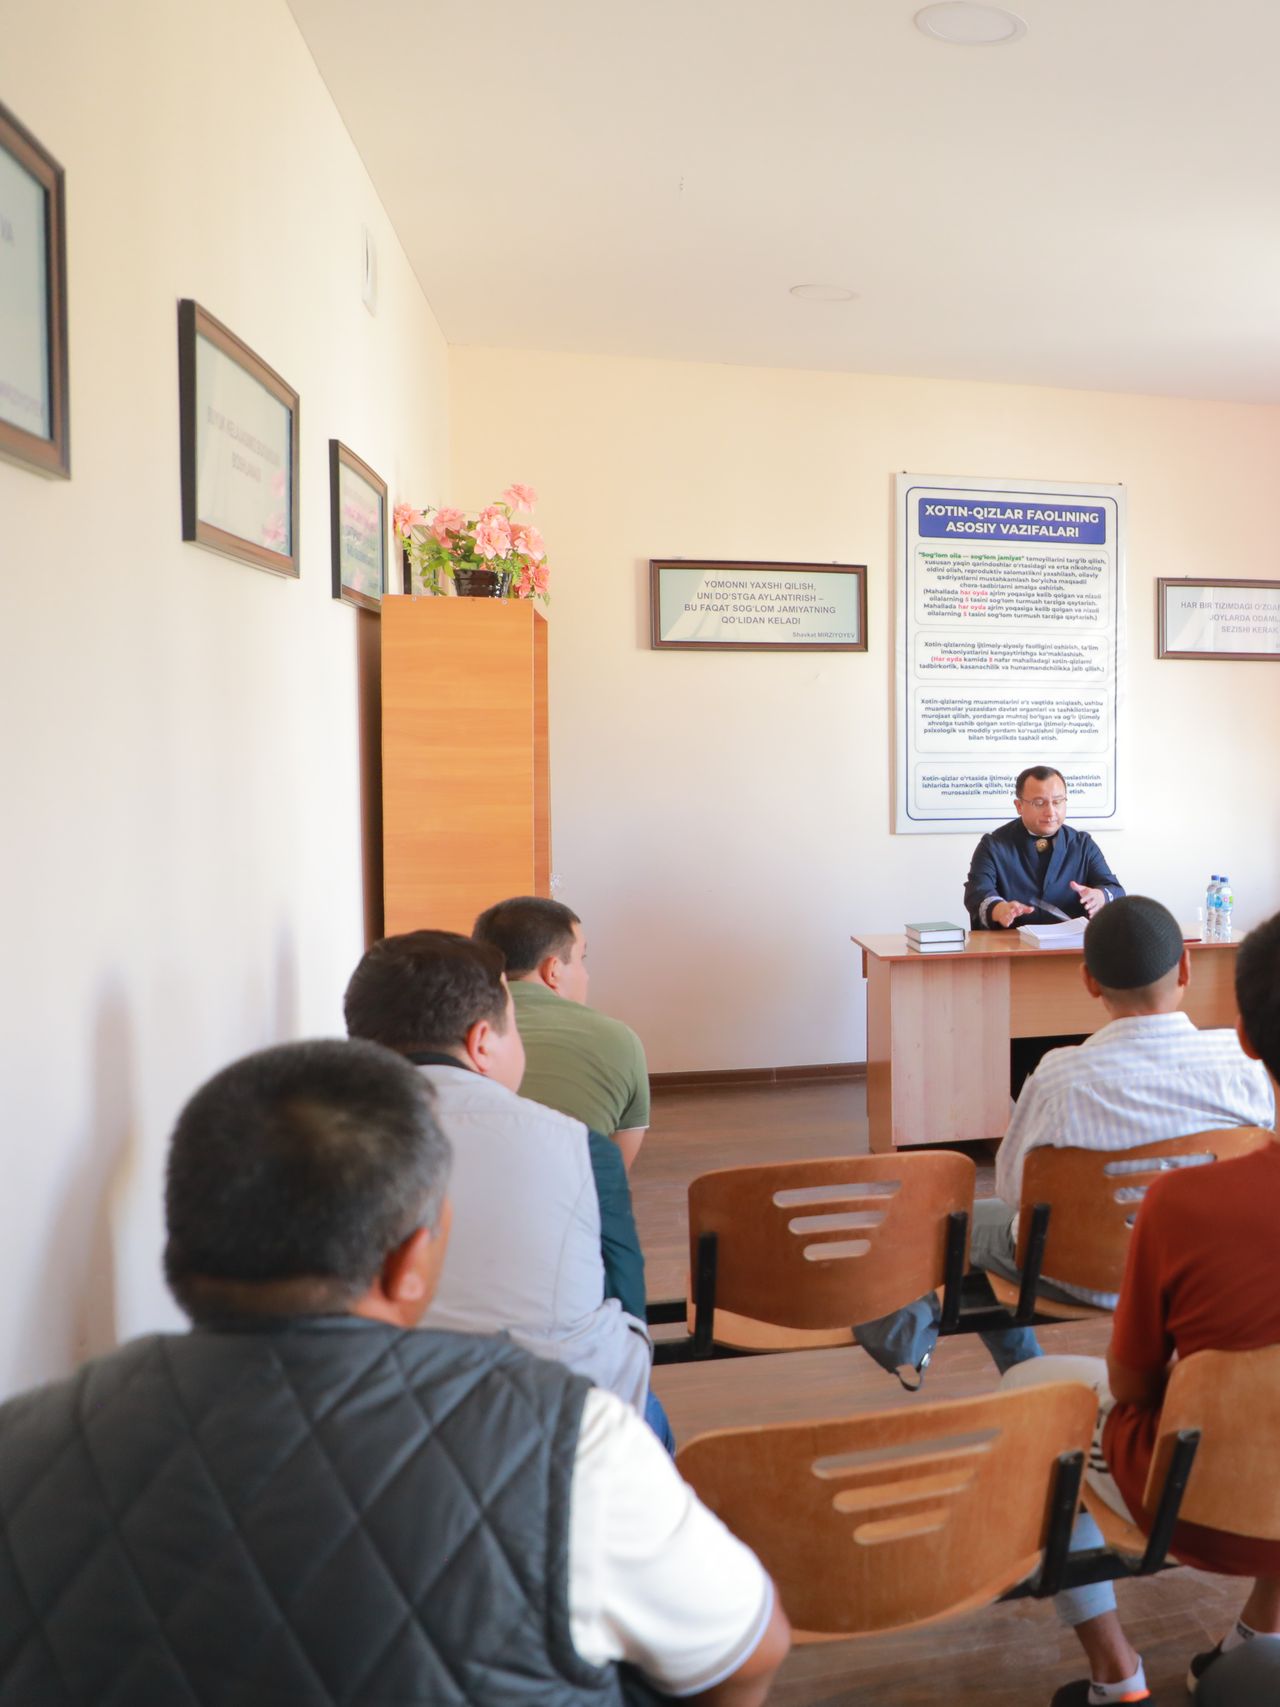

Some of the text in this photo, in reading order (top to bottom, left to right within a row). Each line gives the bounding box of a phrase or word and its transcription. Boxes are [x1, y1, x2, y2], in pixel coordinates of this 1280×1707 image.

[925, 504, 1099, 523] XOTIN-QIZLAR FAOLINING
[946, 521, 1079, 538] ASOSIY VAZIFALARI
[704, 581, 748, 589] YOMONNI
[784, 582, 817, 591] QILISH,
[696, 592, 713, 600] UNI
[715, 593, 756, 601] DO'STGA
[757, 594, 816, 602] AYLANTIRISH
[684, 604, 836, 614] BU FAQAT SOG'LOM JAMIYATNING
[1215, 602, 1253, 610] TIZIMDAGI
[721, 616, 801, 625] QO'LIDAN KELADI
